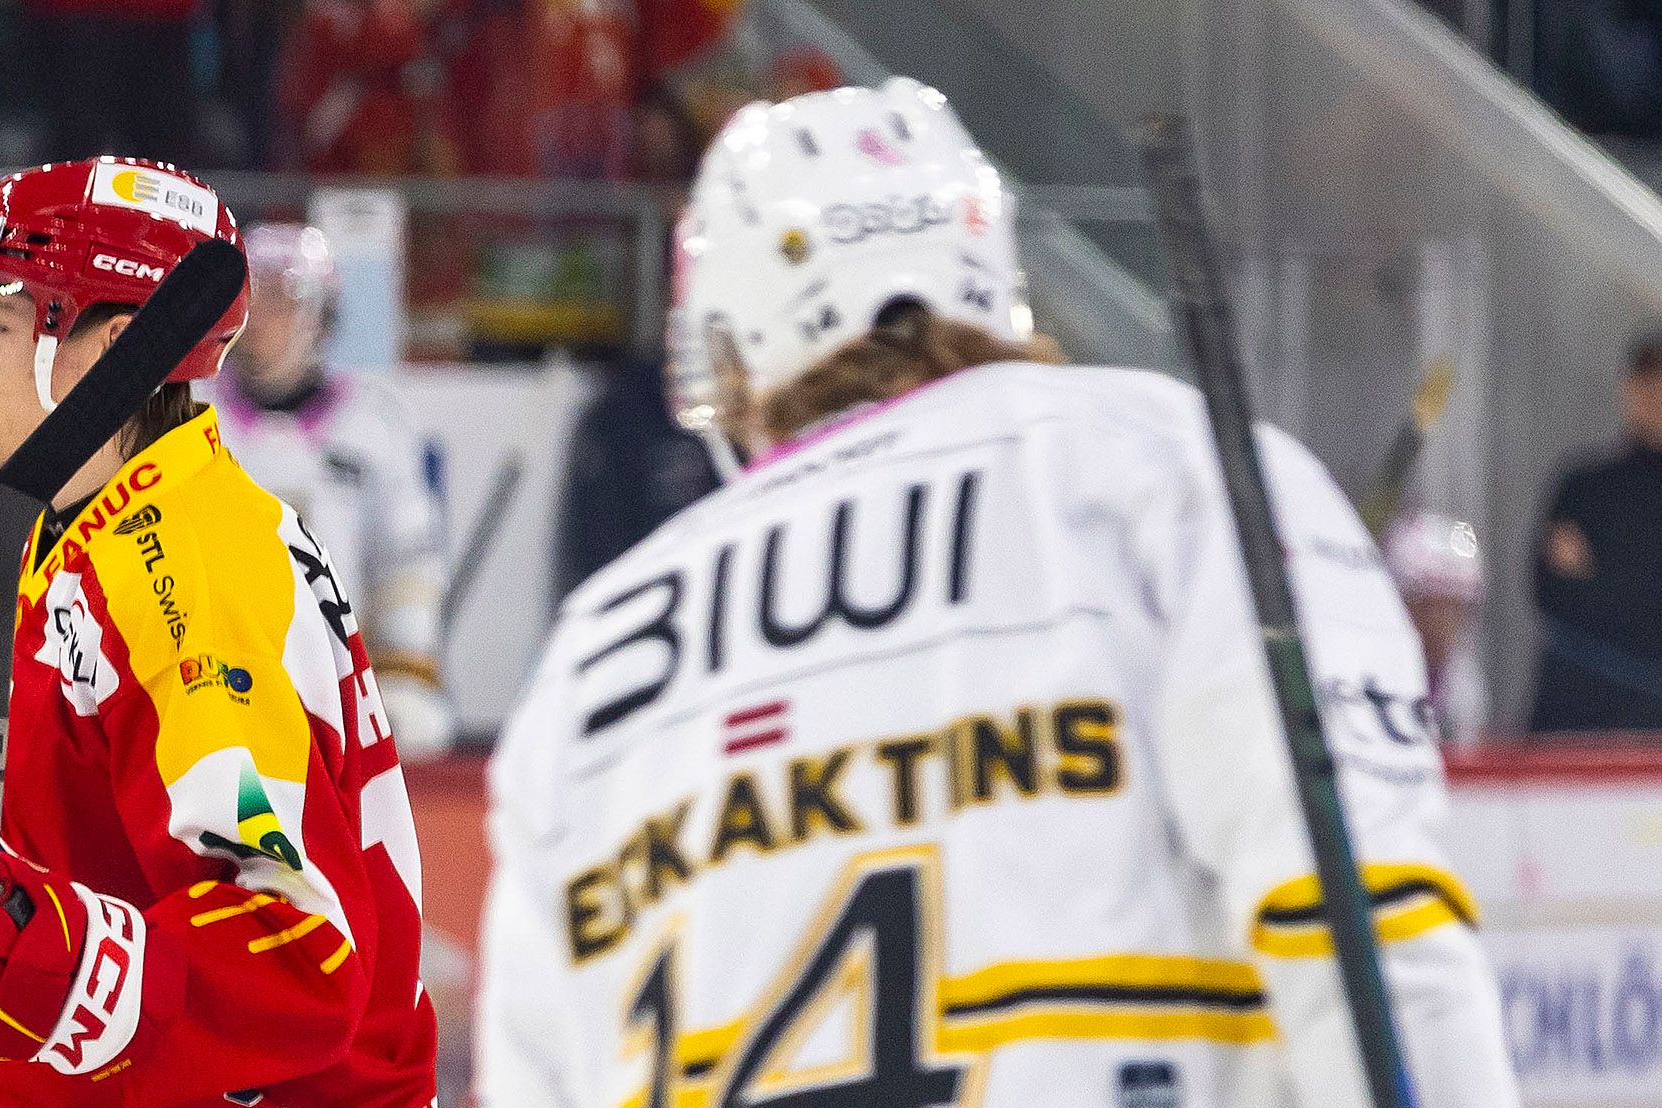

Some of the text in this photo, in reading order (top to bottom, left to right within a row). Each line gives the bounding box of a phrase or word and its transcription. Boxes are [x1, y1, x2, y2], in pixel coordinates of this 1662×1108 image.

[92, 253, 165, 282] CCM
[44, 460, 163, 579] FANUC
[137, 531, 166, 576] STL
